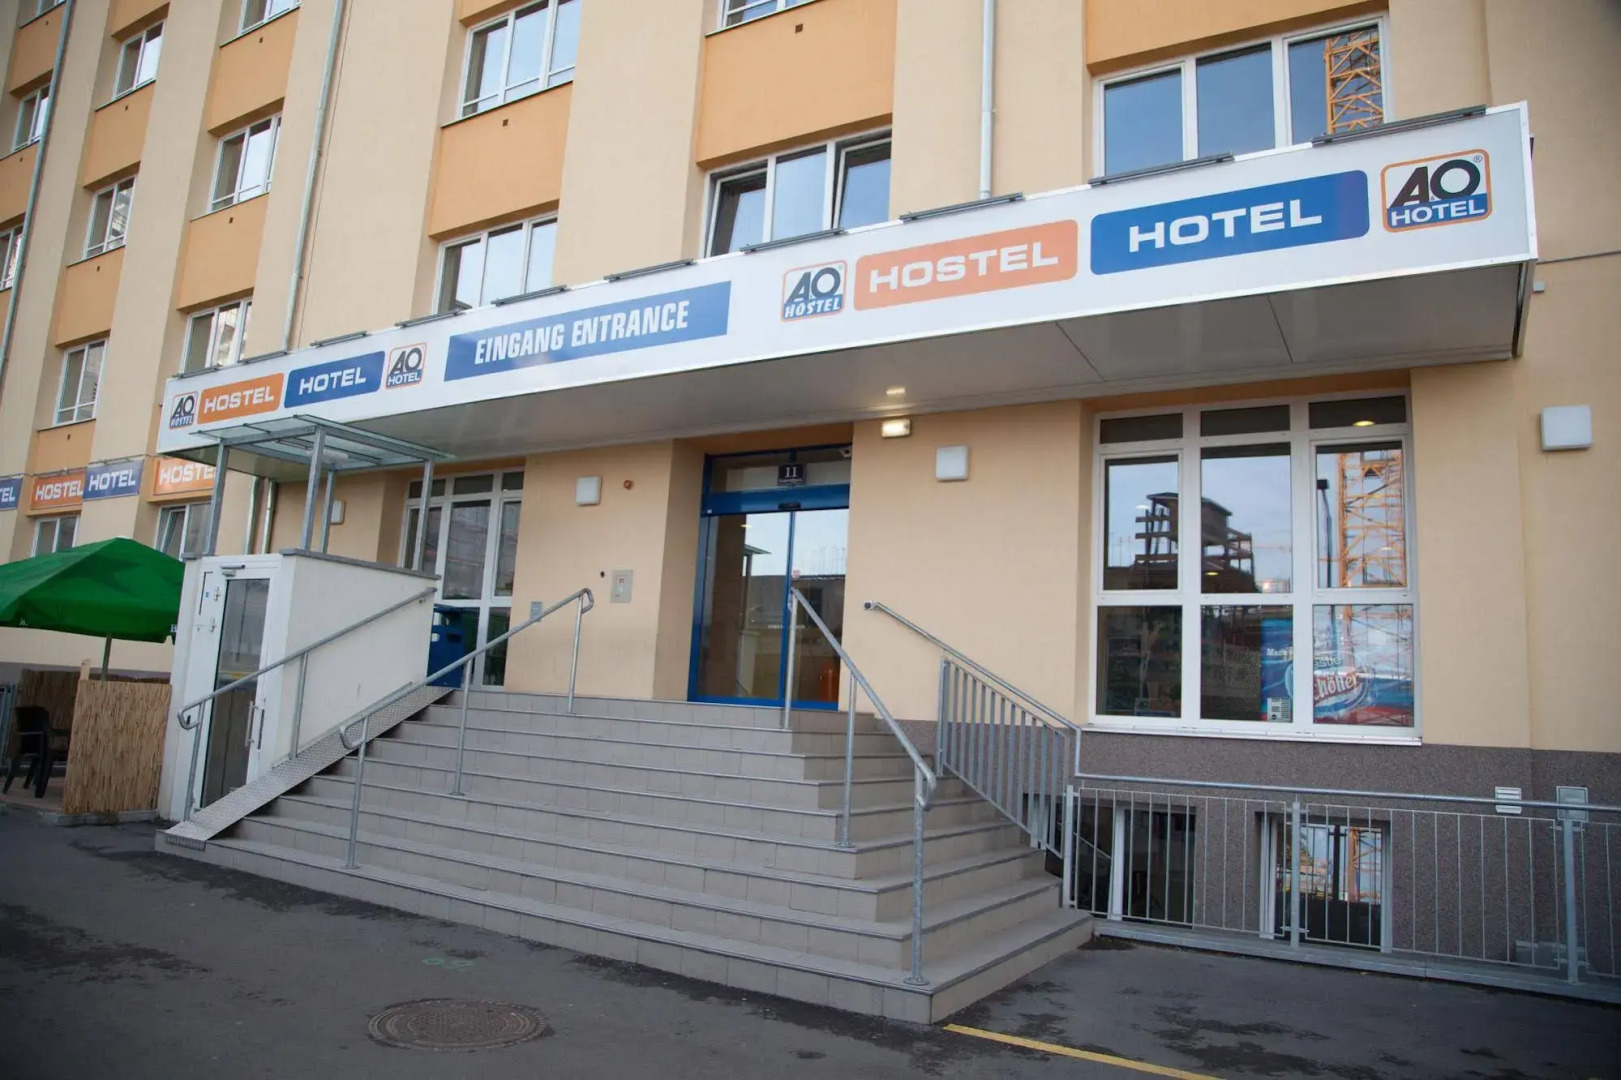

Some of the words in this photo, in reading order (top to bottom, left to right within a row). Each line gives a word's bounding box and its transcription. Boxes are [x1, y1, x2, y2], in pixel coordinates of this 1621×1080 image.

[1129, 199, 1322, 253] HOTEL
[1391, 200, 1485, 226] HOTEL
[869, 242, 1058, 293] HOSTEL
[784, 297, 841, 318] HOSTEL
[474, 323, 564, 365] EINGANG
[571, 300, 690, 348] ENTRANCE
[299, 367, 366, 395] HOTEL
[387, 371, 420, 386] HOTEL
[204, 386, 274, 414] HOSTEL
[88, 469, 136, 492] HOTEL
[785, 466, 797, 478] 11
[35, 481, 83, 500] HOSTEL
